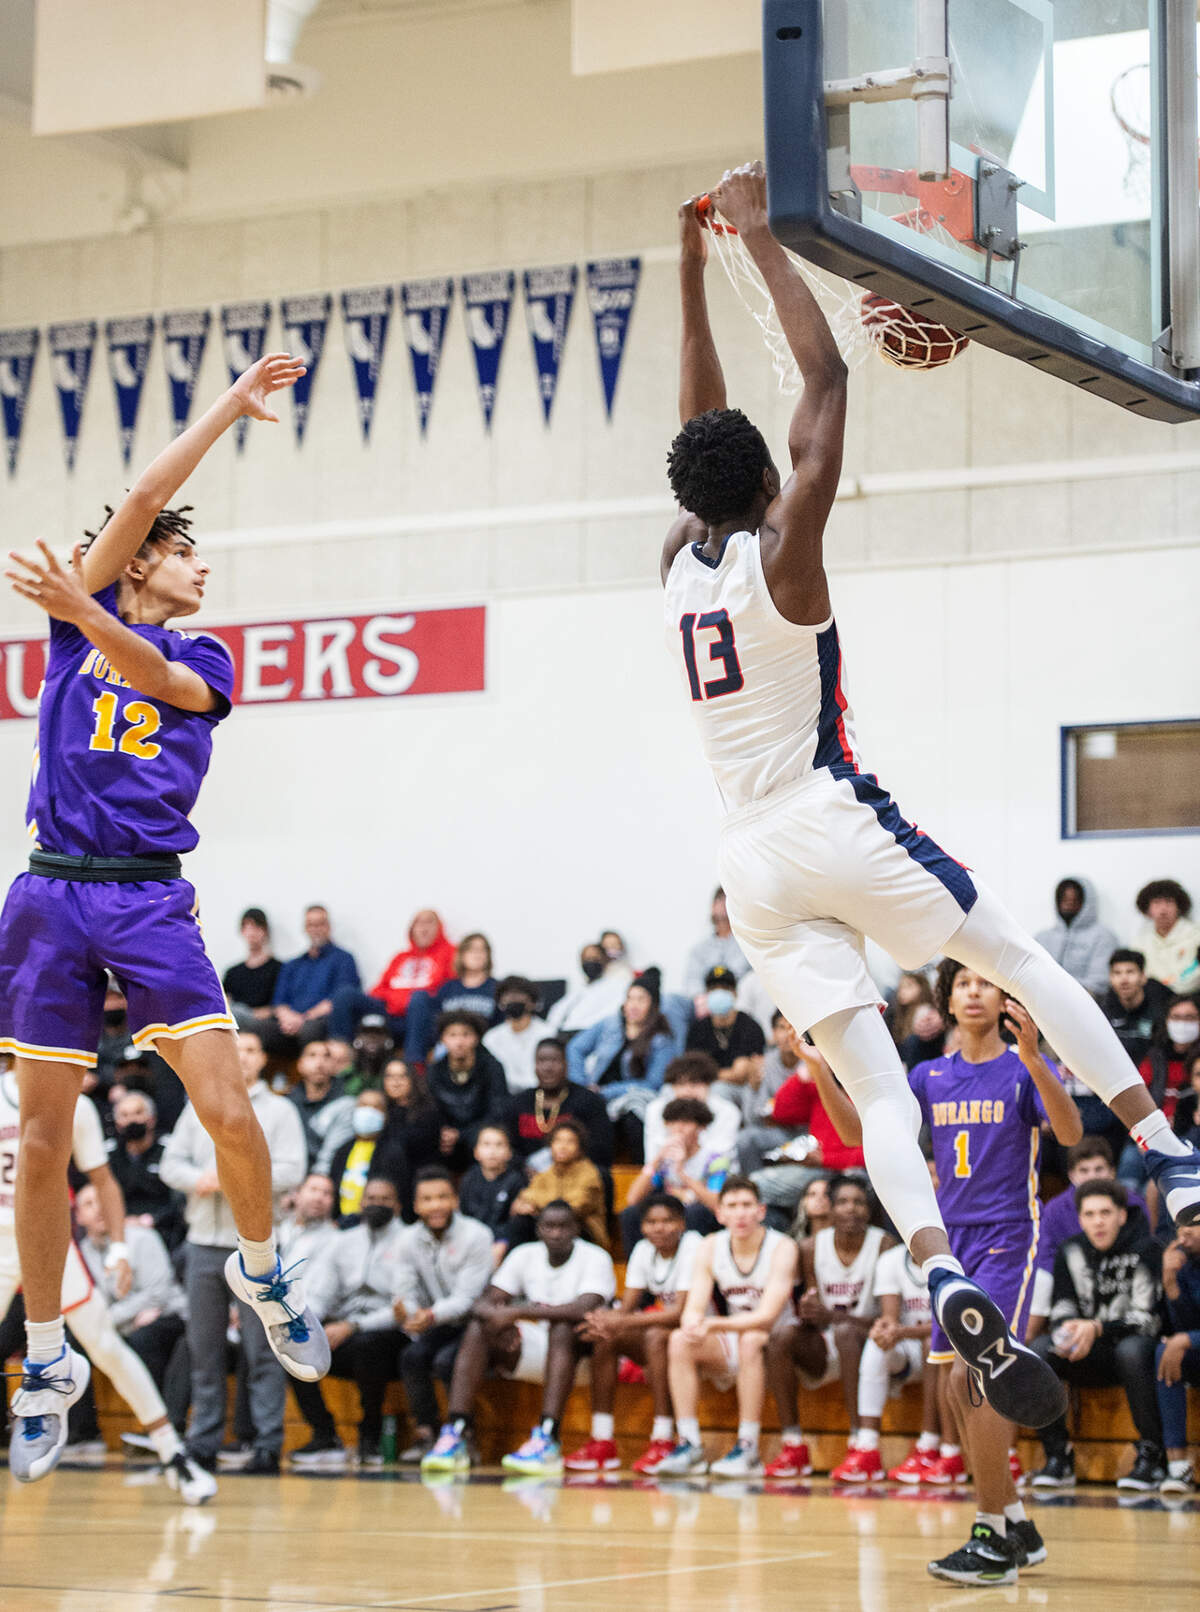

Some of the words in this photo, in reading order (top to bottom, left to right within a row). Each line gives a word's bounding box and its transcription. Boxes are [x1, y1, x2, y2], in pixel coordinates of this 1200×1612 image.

[680, 608, 744, 701] 13
[89, 690, 163, 760] 12
[953, 1130, 971, 1178] 1
